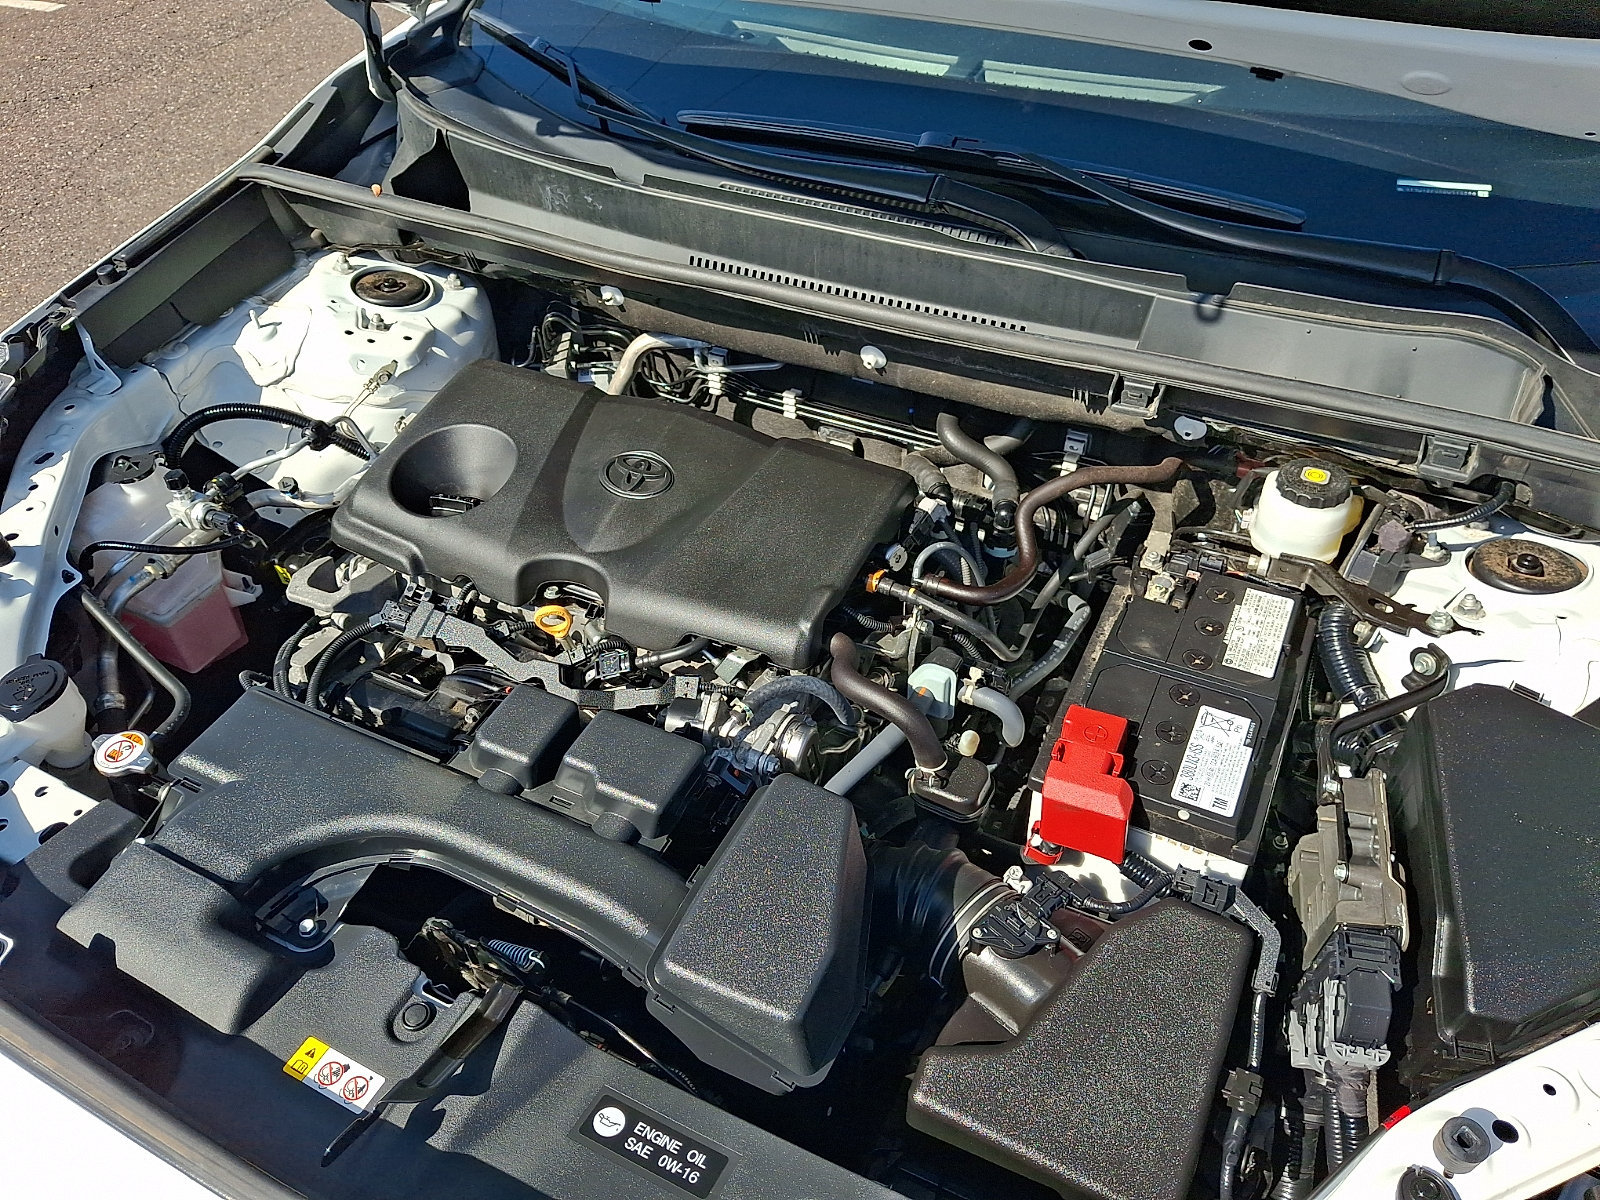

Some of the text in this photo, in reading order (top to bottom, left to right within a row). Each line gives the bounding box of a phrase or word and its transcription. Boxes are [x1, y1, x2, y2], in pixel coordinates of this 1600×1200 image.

[624, 1137, 700, 1184] SAE 0W-16
[633, 1121, 707, 1170] ENGINE OIL
